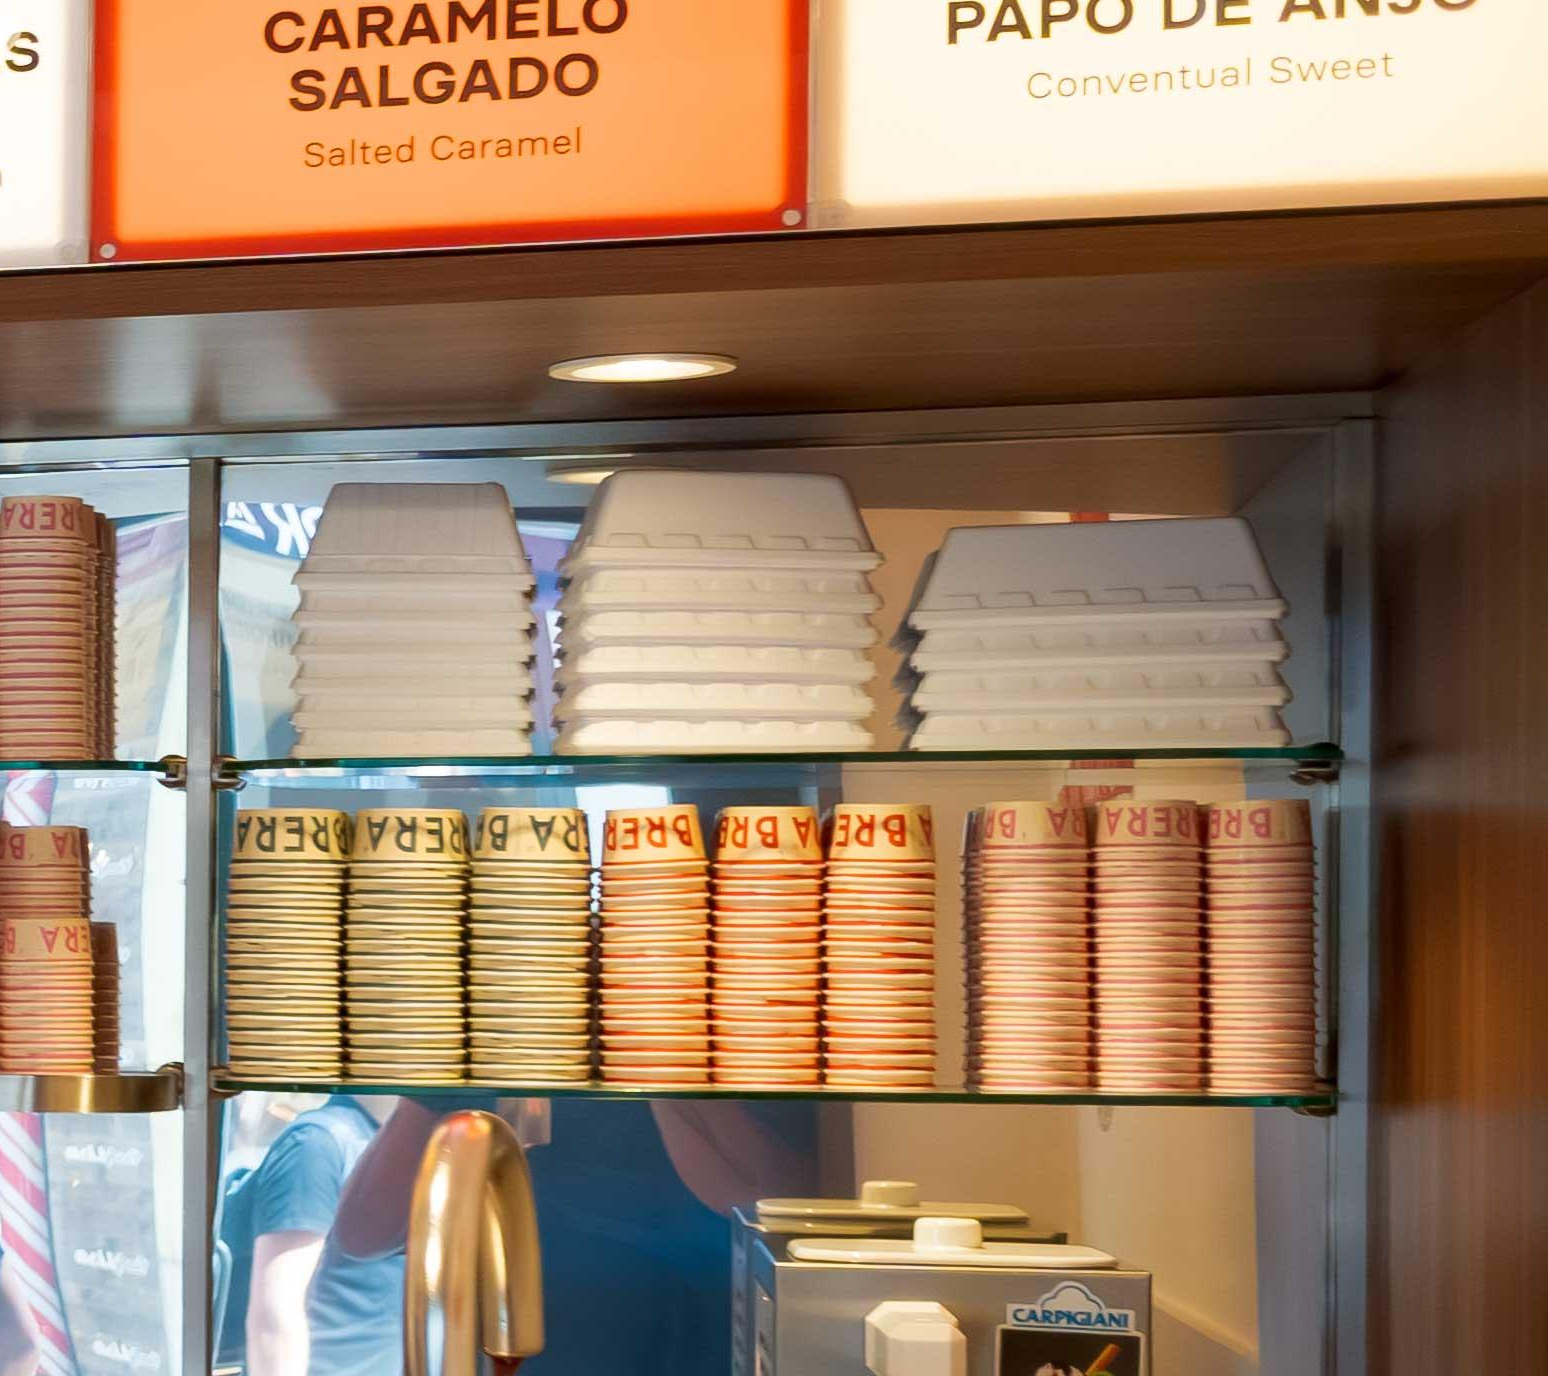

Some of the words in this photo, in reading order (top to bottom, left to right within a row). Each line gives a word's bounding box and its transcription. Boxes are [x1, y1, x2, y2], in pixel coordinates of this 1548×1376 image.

[287, 50, 598, 111] SALGADO
[1025, 58, 1250, 99] Conventual
[1267, 48, 1393, 88] Sweet
[303, 132, 414, 167] Salted
[428, 124, 580, 160] Caramel
[1012, 1308, 1129, 1328] CARPIGIANI
